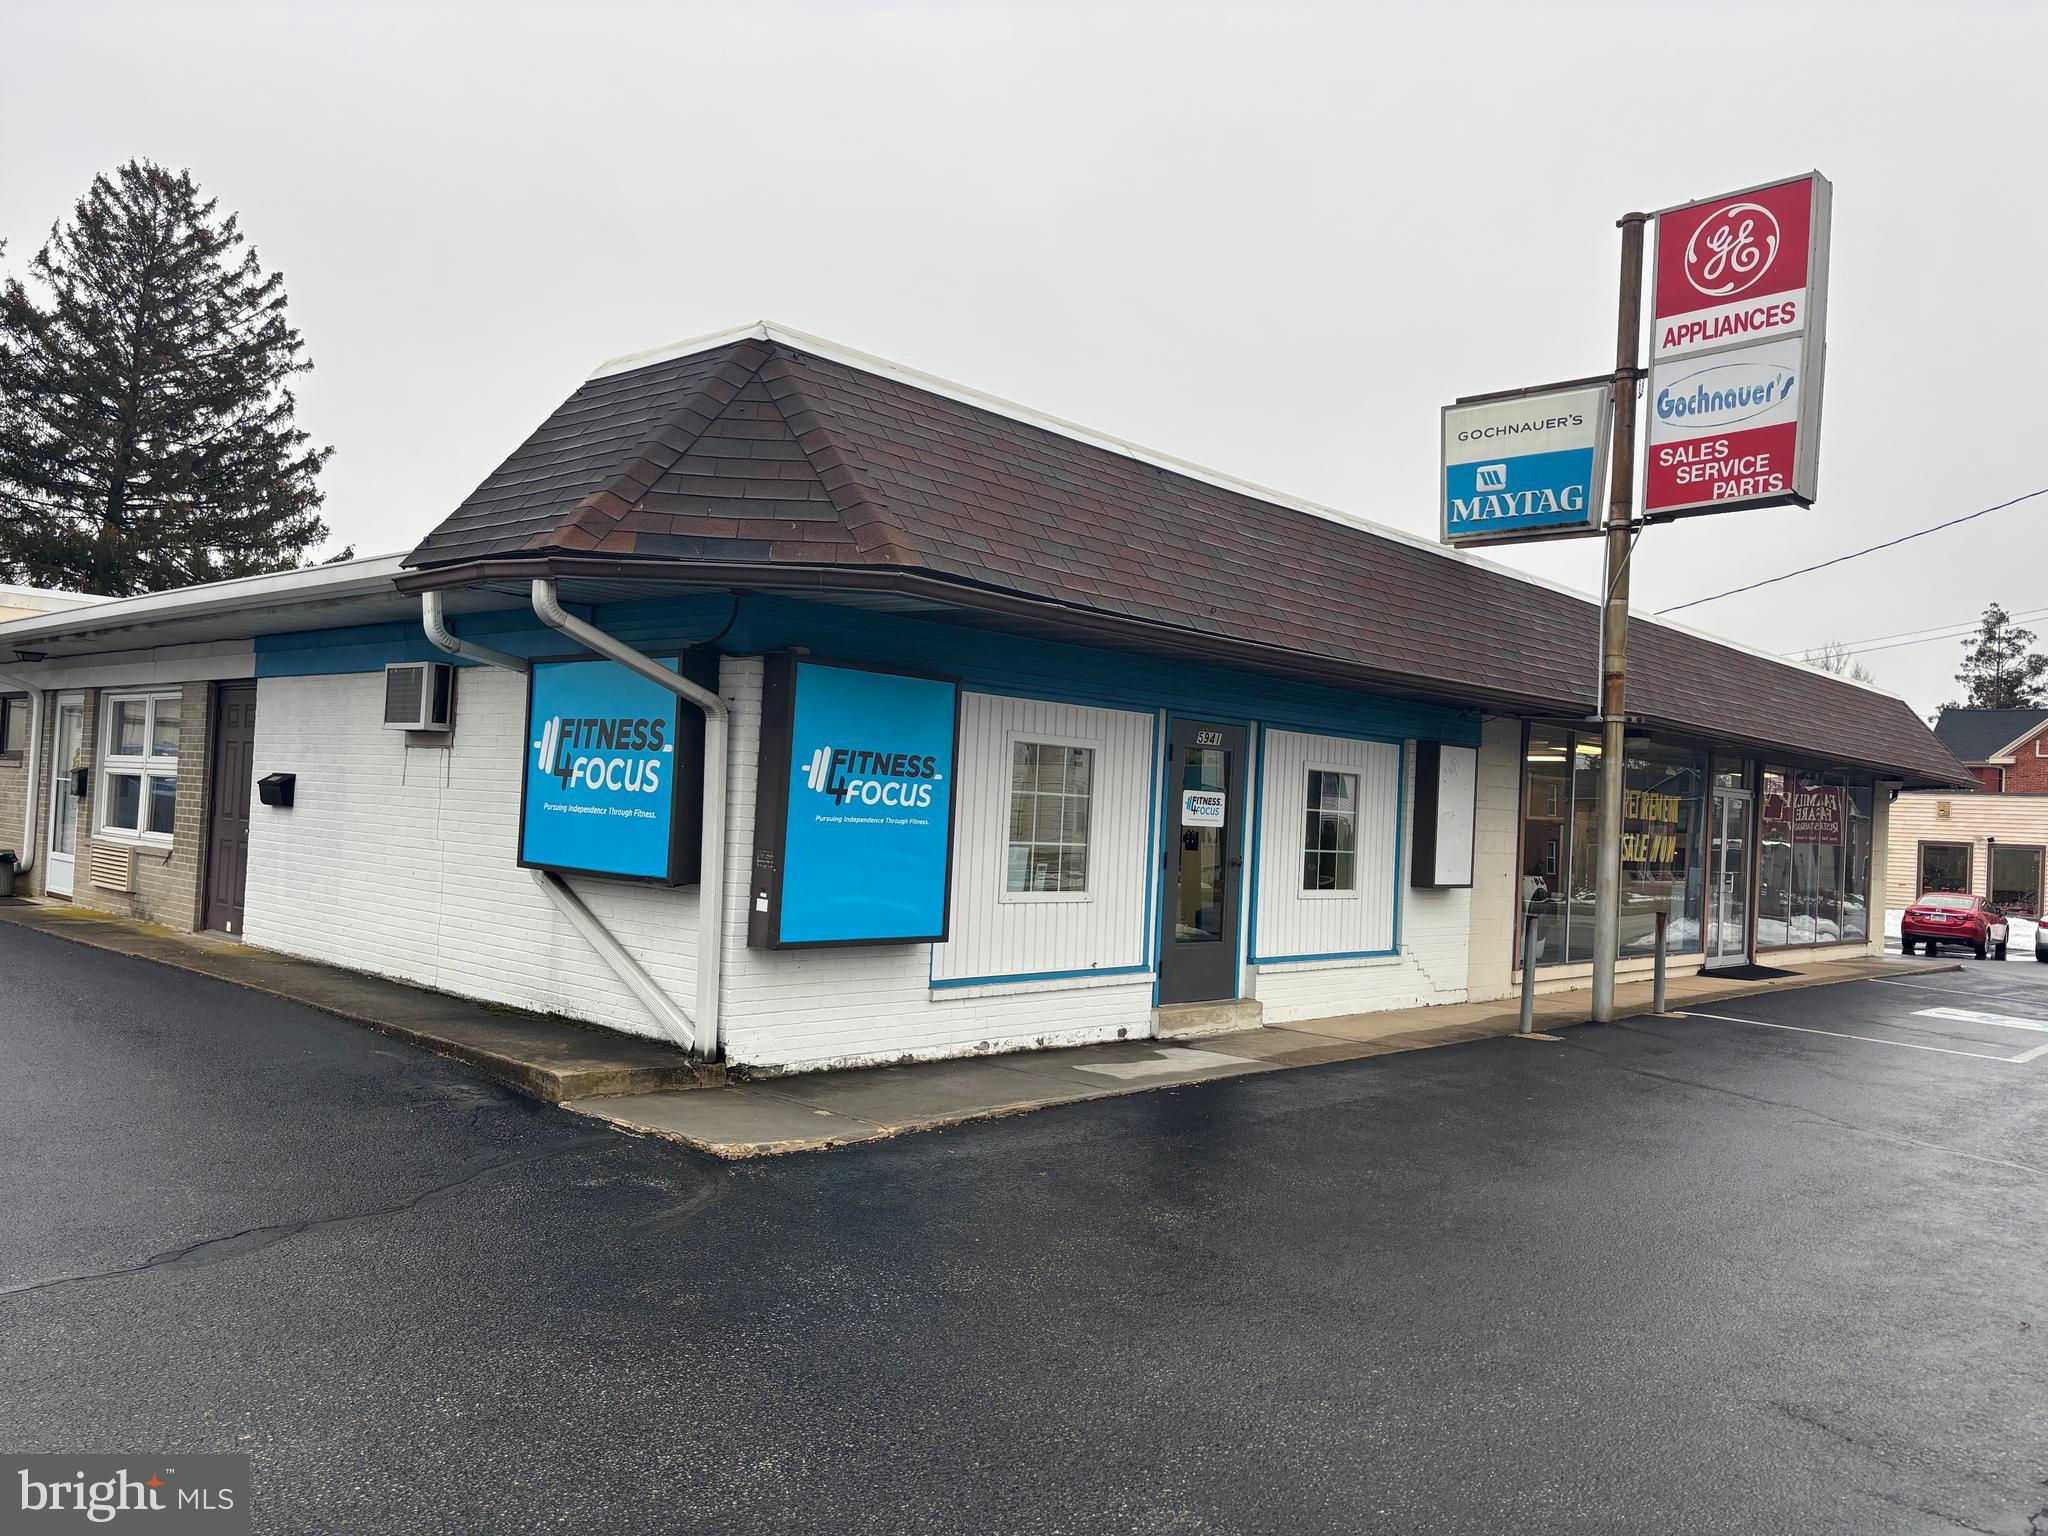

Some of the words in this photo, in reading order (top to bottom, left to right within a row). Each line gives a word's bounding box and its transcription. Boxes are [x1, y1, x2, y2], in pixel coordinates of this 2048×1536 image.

[1704, 219, 1760, 280] GE
[1663, 301, 1796, 348] APPLIANCES
[1657, 373, 1795, 419] Gochnauer's
[1458, 414, 1583, 441] GOCHNAUER'S
[1659, 440, 1729, 467] SALES
[1676, 453, 1770, 485] SERVICE
[1713, 473, 1784, 499] PARTS
[1450, 485, 1583, 523] MAYTAG
[558, 718, 666, 752] FITNESS
[1198, 732, 1223, 745] 5941
[831, 749, 937, 779] FITNESS
[544, 803, 567, 813] Pursuing
[568, 805, 607, 815] Independence
[608, 807, 632, 818] Through
[1192, 796, 1221, 806] FITNESS
[815, 815, 842, 824] Pursuing
[843, 816, 884, 825] Independence
[885, 817, 909, 825] Through
